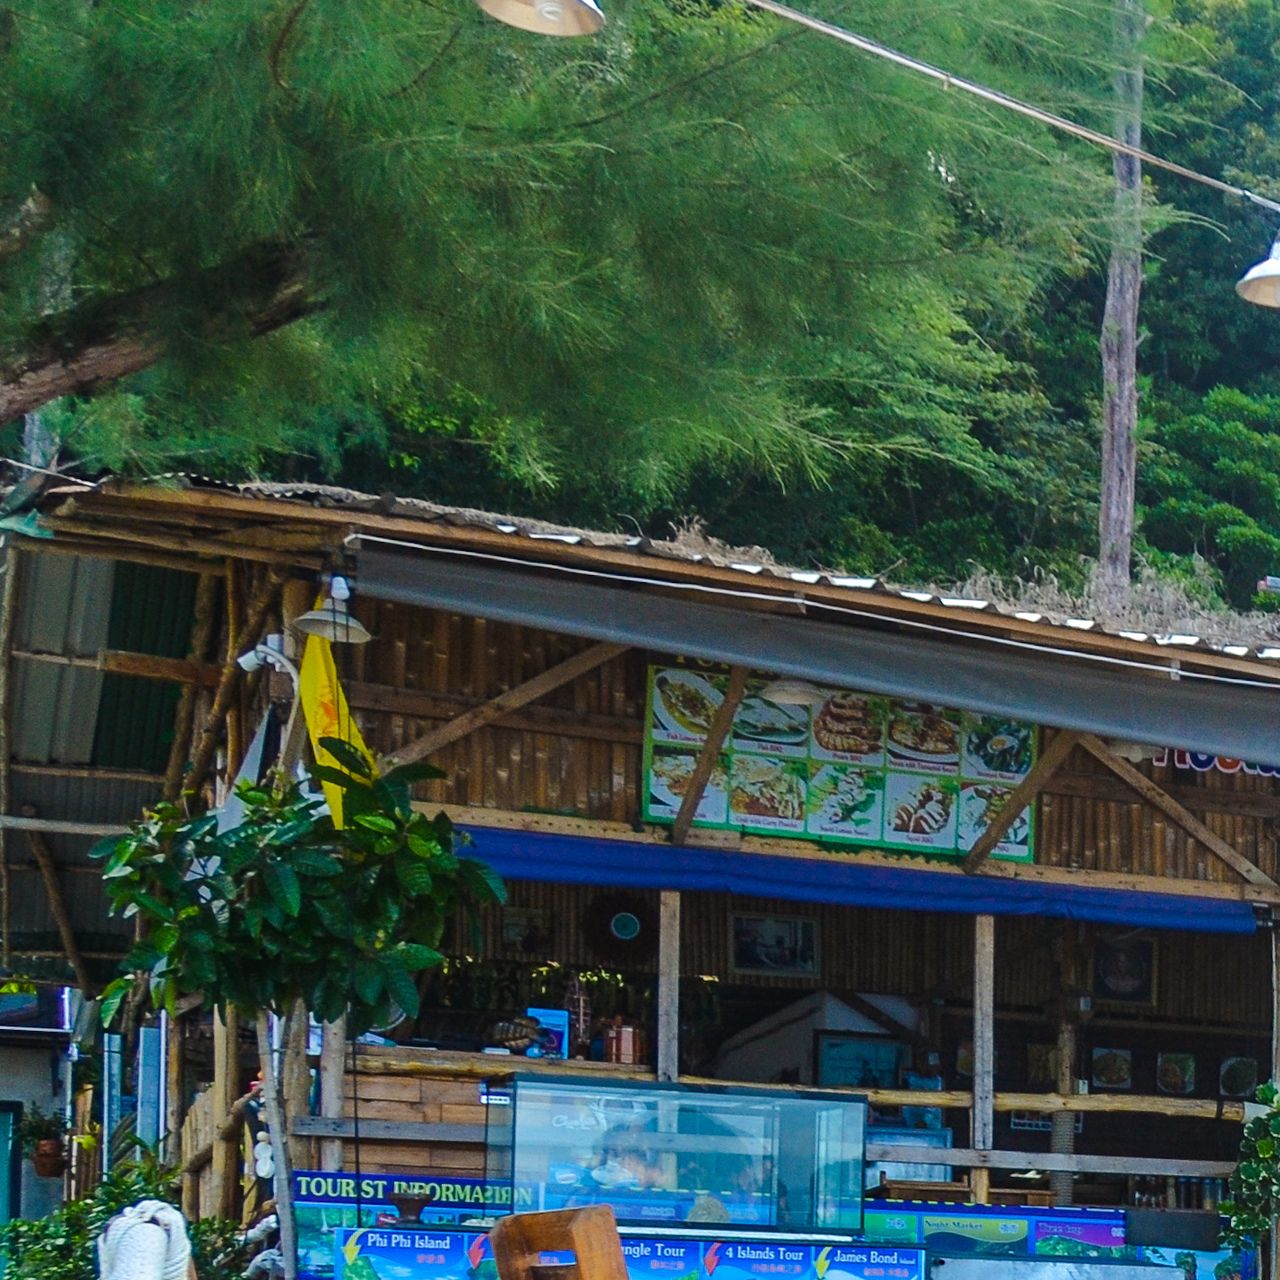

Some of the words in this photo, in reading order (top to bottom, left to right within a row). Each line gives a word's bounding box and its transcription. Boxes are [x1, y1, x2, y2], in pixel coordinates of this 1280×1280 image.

[297, 1176, 387, 1199] TOURST
[367, 1233, 388, 1247] Phi
[391, 1234, 412, 1248] Phi
[415, 1235, 450, 1249] Island
[654, 1243, 686, 1257] Tour
[725, 1248, 733, 1259] 4
[736, 1246, 774, 1260] Islands
[777, 1248, 804, 1261] Tour
[834, 1249, 867, 1262] James
[870, 1251, 898, 1264] Bond
